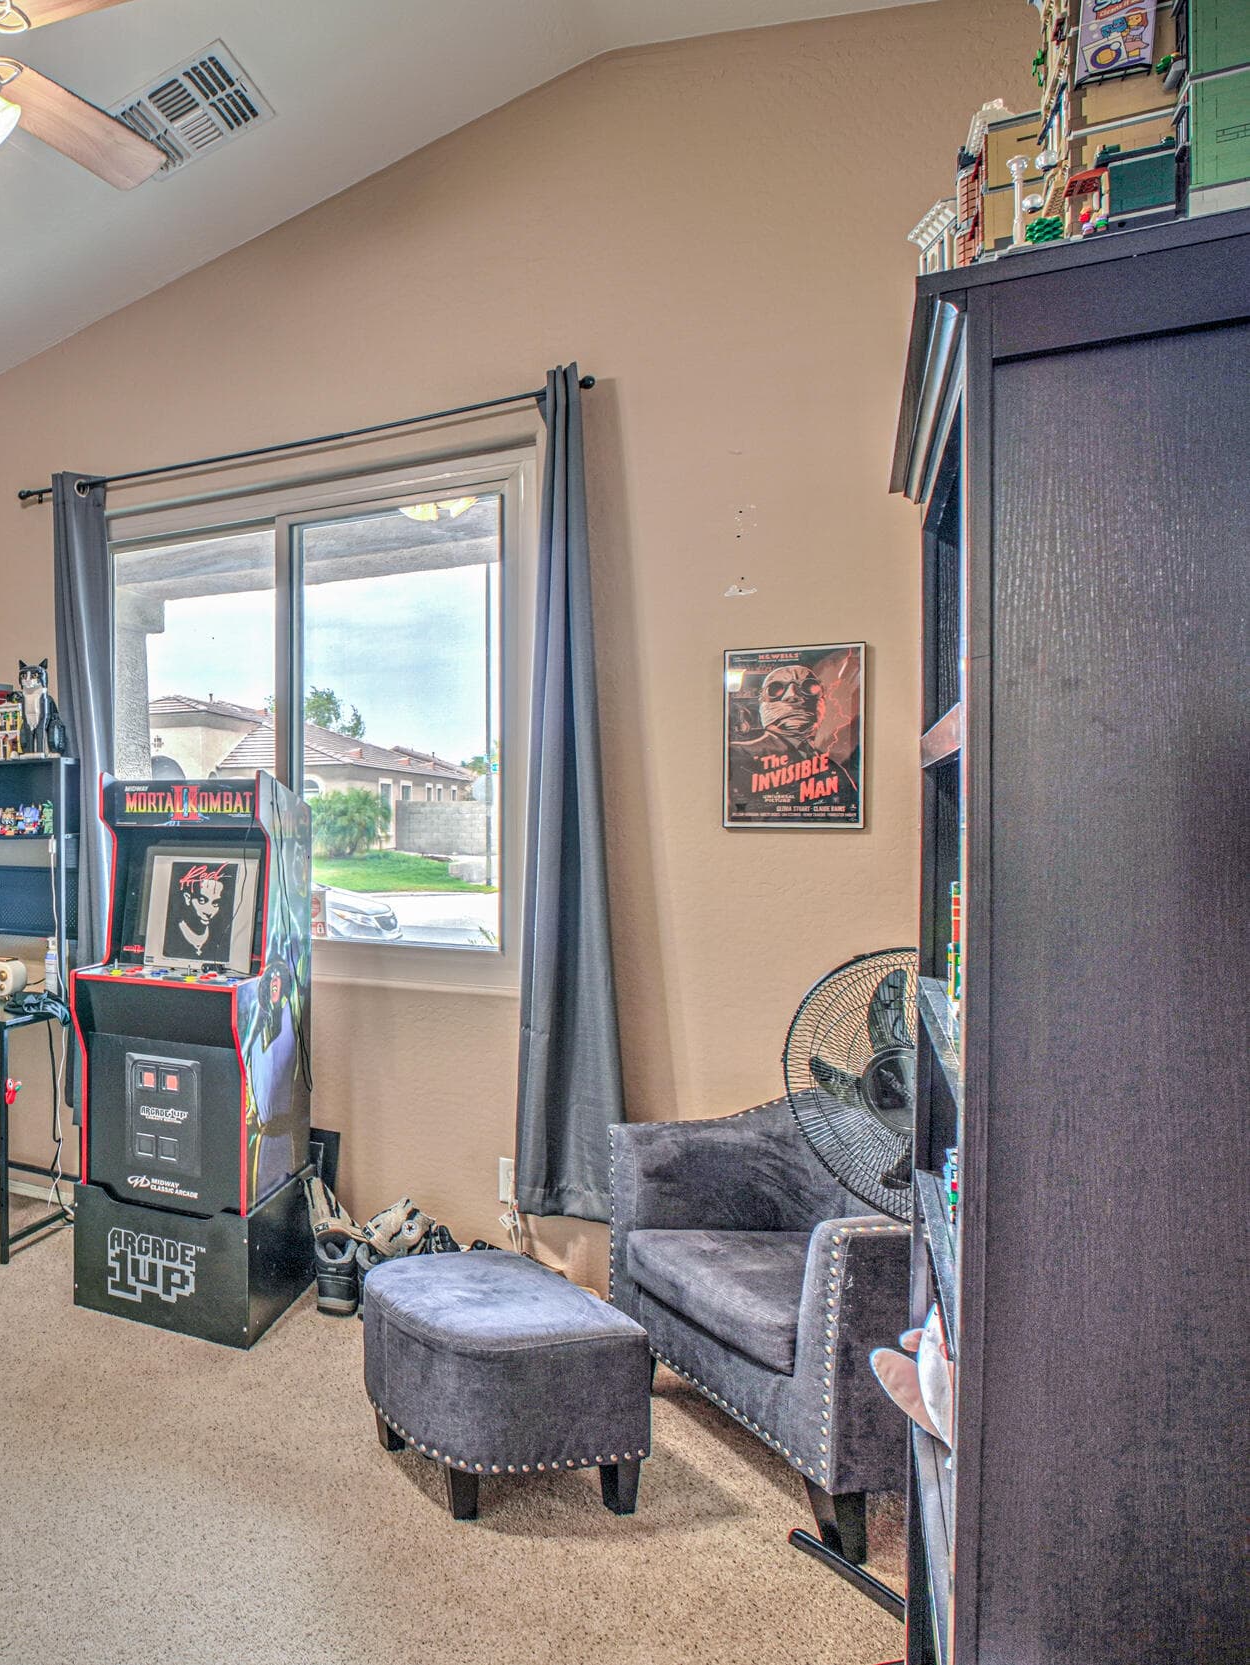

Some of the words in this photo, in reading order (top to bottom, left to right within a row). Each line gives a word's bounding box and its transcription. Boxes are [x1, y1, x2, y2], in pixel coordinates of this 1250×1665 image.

[752, 751, 829, 793] INVISIBLE
[125, 792, 186, 813] MORTAL
[187, 791, 253, 813] KOMBAT
[179, 861, 231, 885] Red
[150, 1185, 175, 1194] CLASSIC
[174, 1188, 199, 1199] ARCADE
[151, 1177, 180, 1188] MIDWAY
[108, 1227, 196, 1270] ARCADE
[108, 1249, 196, 1304] 1UP
